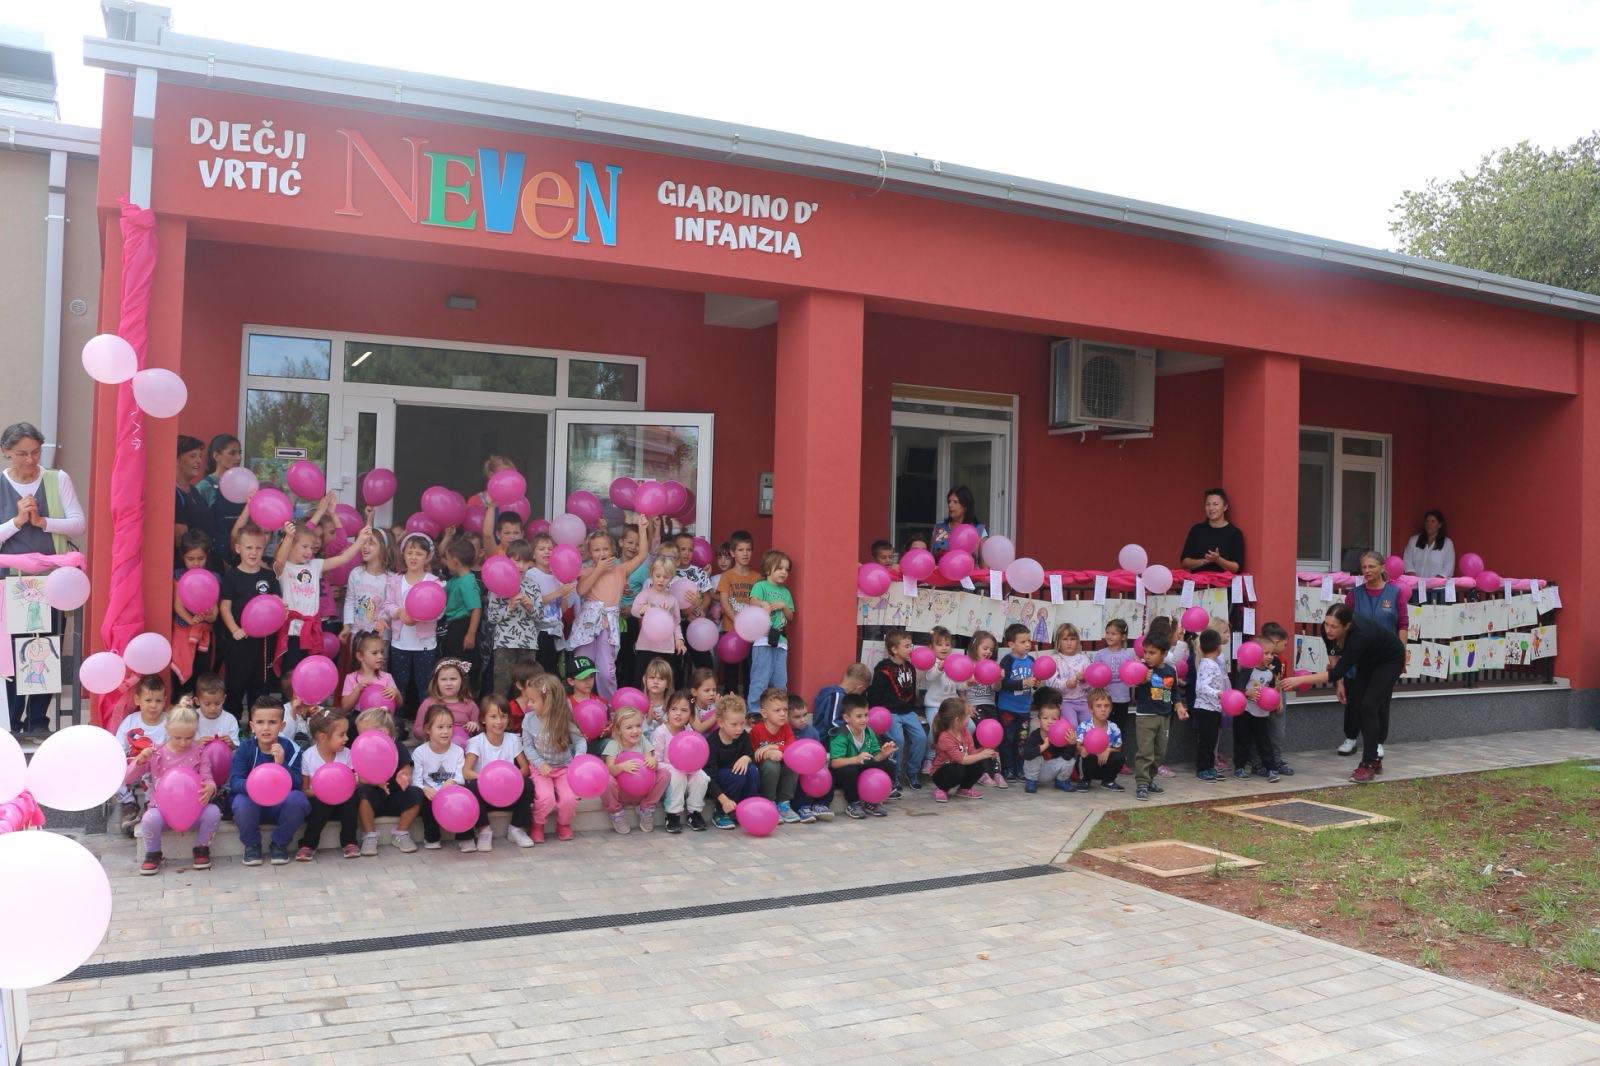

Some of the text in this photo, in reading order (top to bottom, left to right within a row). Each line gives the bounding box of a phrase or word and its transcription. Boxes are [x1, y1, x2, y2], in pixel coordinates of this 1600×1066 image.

[190, 117, 306, 159] DJEČJI
[198, 157, 302, 196] VRTIĆ
[657, 180, 819, 224] GIARDINO D'
[674, 216, 802, 259] INFANZIA
